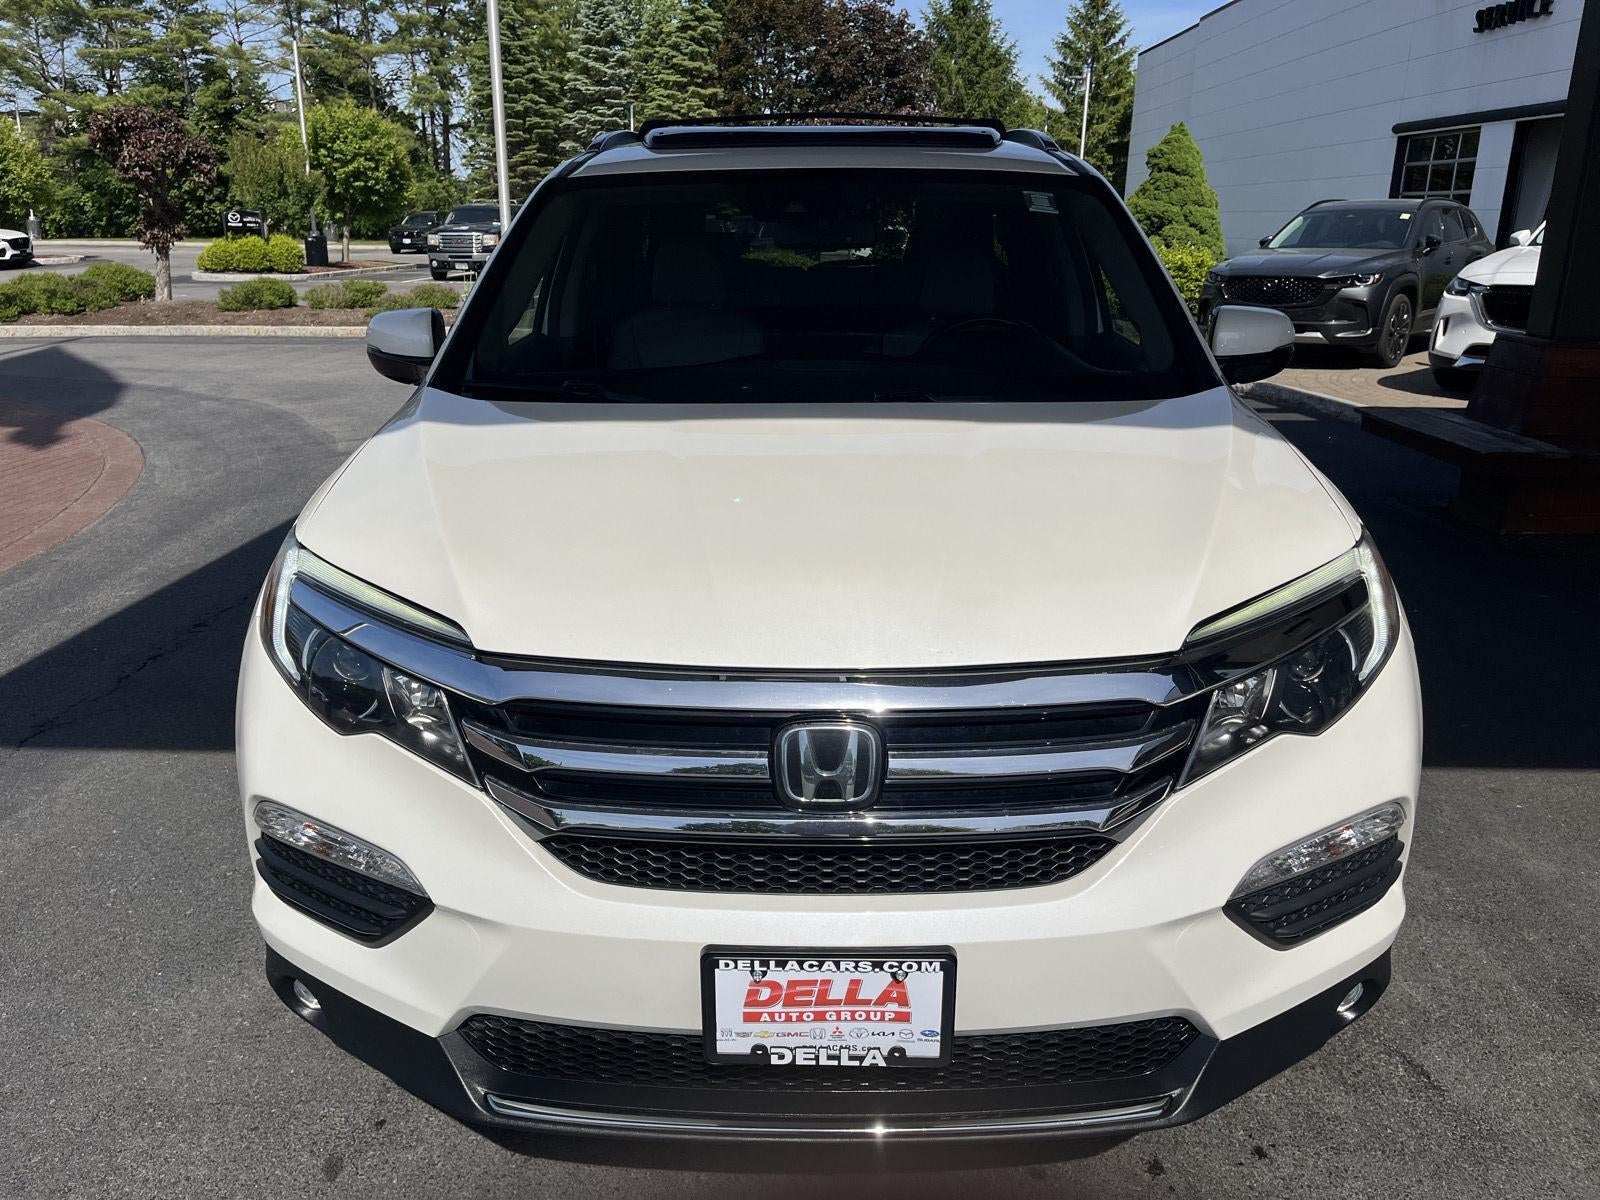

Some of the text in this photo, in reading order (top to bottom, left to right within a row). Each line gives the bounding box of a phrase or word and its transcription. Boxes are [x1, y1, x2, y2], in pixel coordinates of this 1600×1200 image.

[718, 960, 941, 973] DELLACARS.COM
[743, 978, 911, 1008] DELLA
[760, 1011, 896, 1022] AUTO GROUP
[769, 1047, 887, 1066] DELLA
